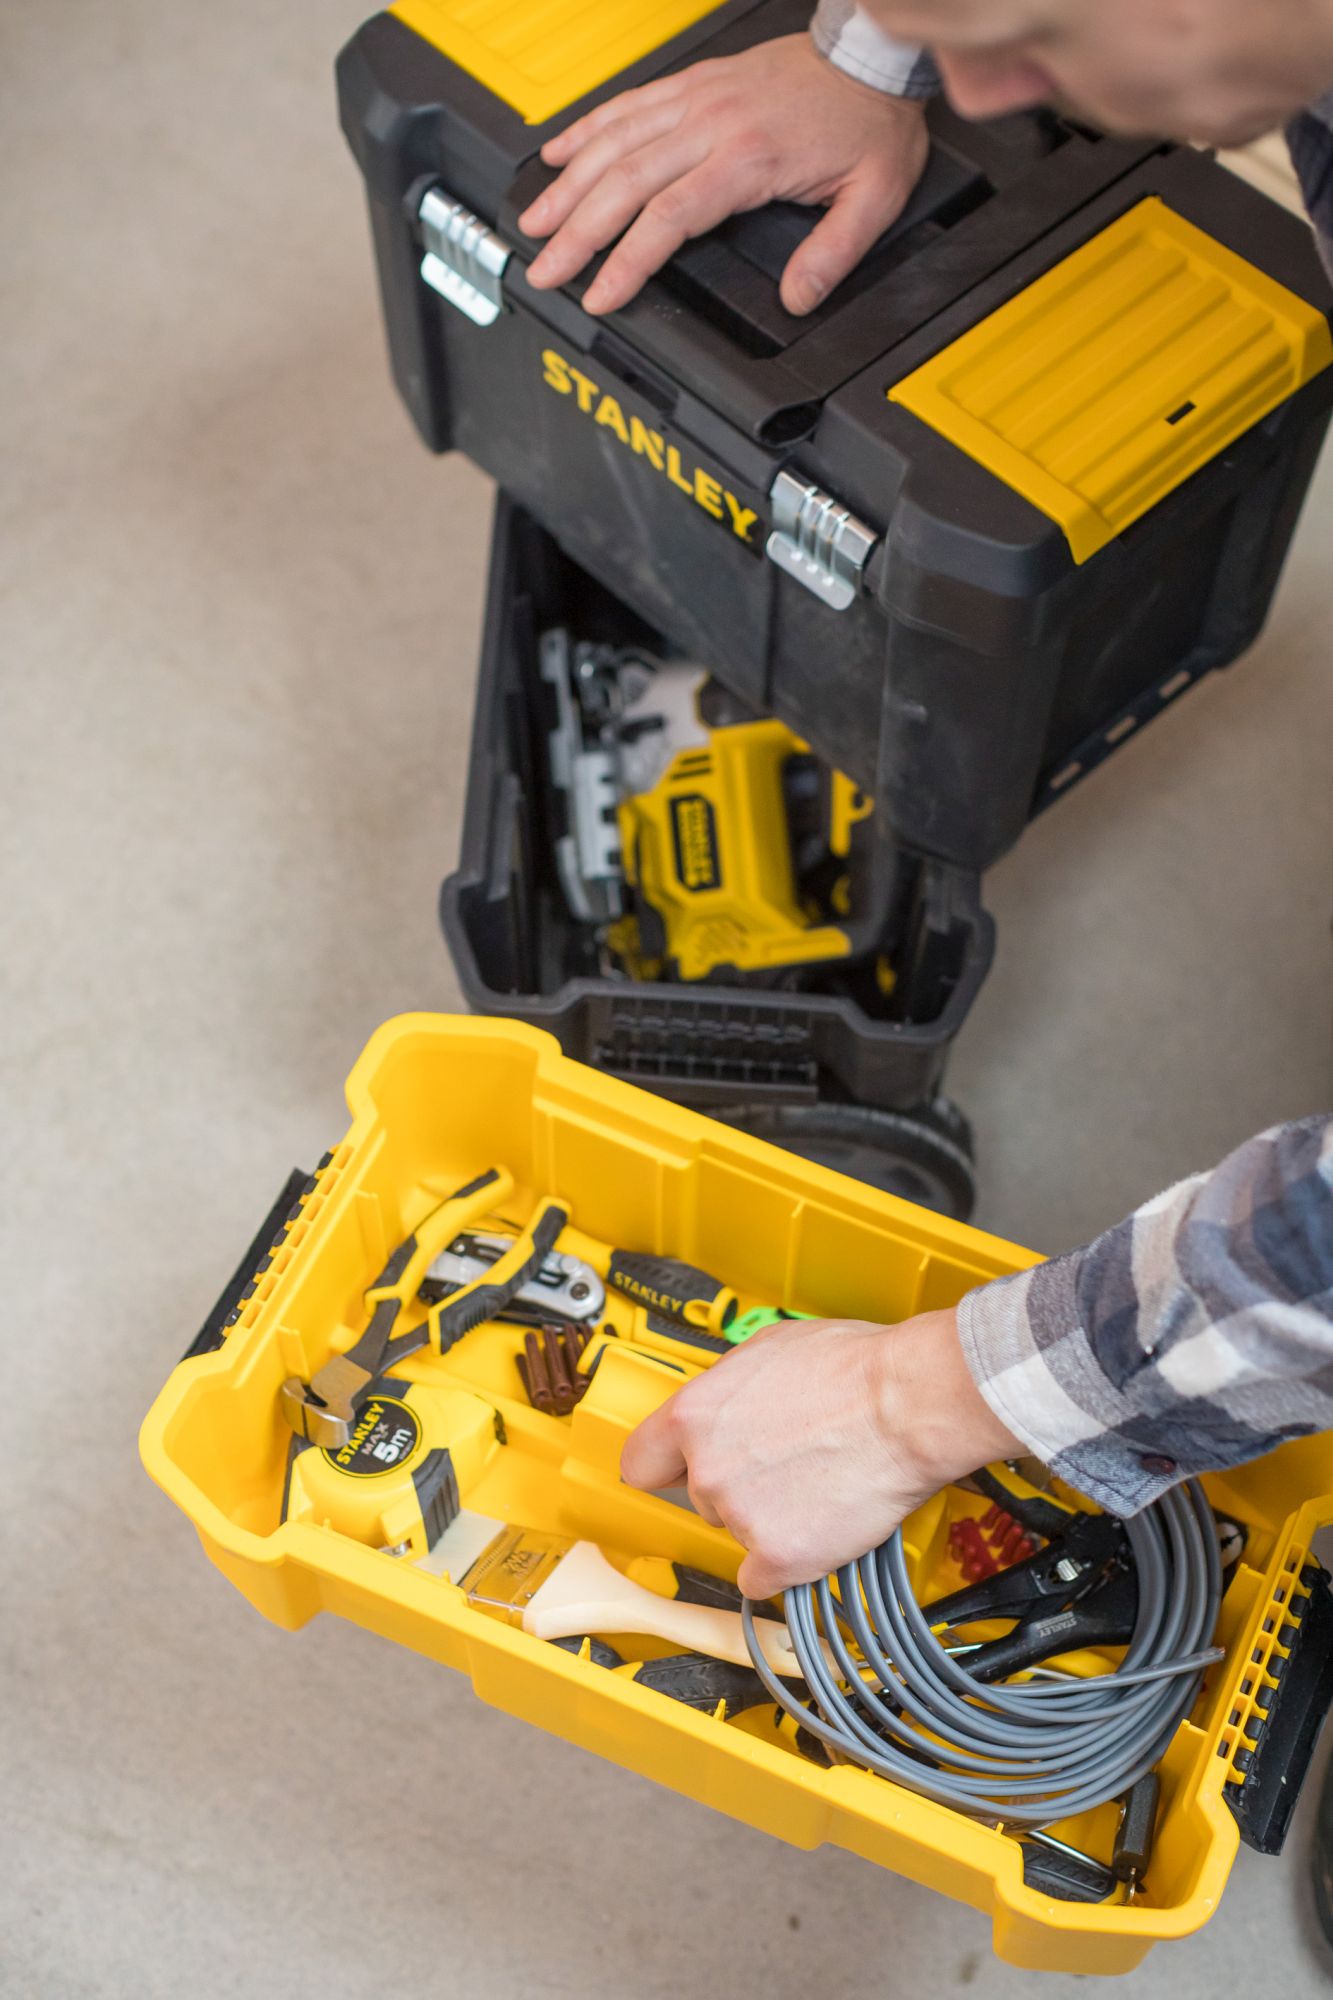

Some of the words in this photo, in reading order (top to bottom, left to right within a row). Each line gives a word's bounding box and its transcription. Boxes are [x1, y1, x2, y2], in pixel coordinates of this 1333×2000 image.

[541, 348, 759, 542] STANLEY
[614, 1272, 682, 1312] STANLEY
[336, 1402, 385, 1465] STANLEY
[361, 1422, 389, 1455] MAX
[372, 1428, 412, 1463] 5m
[1040, 1617, 1077, 1637] STANLEY
